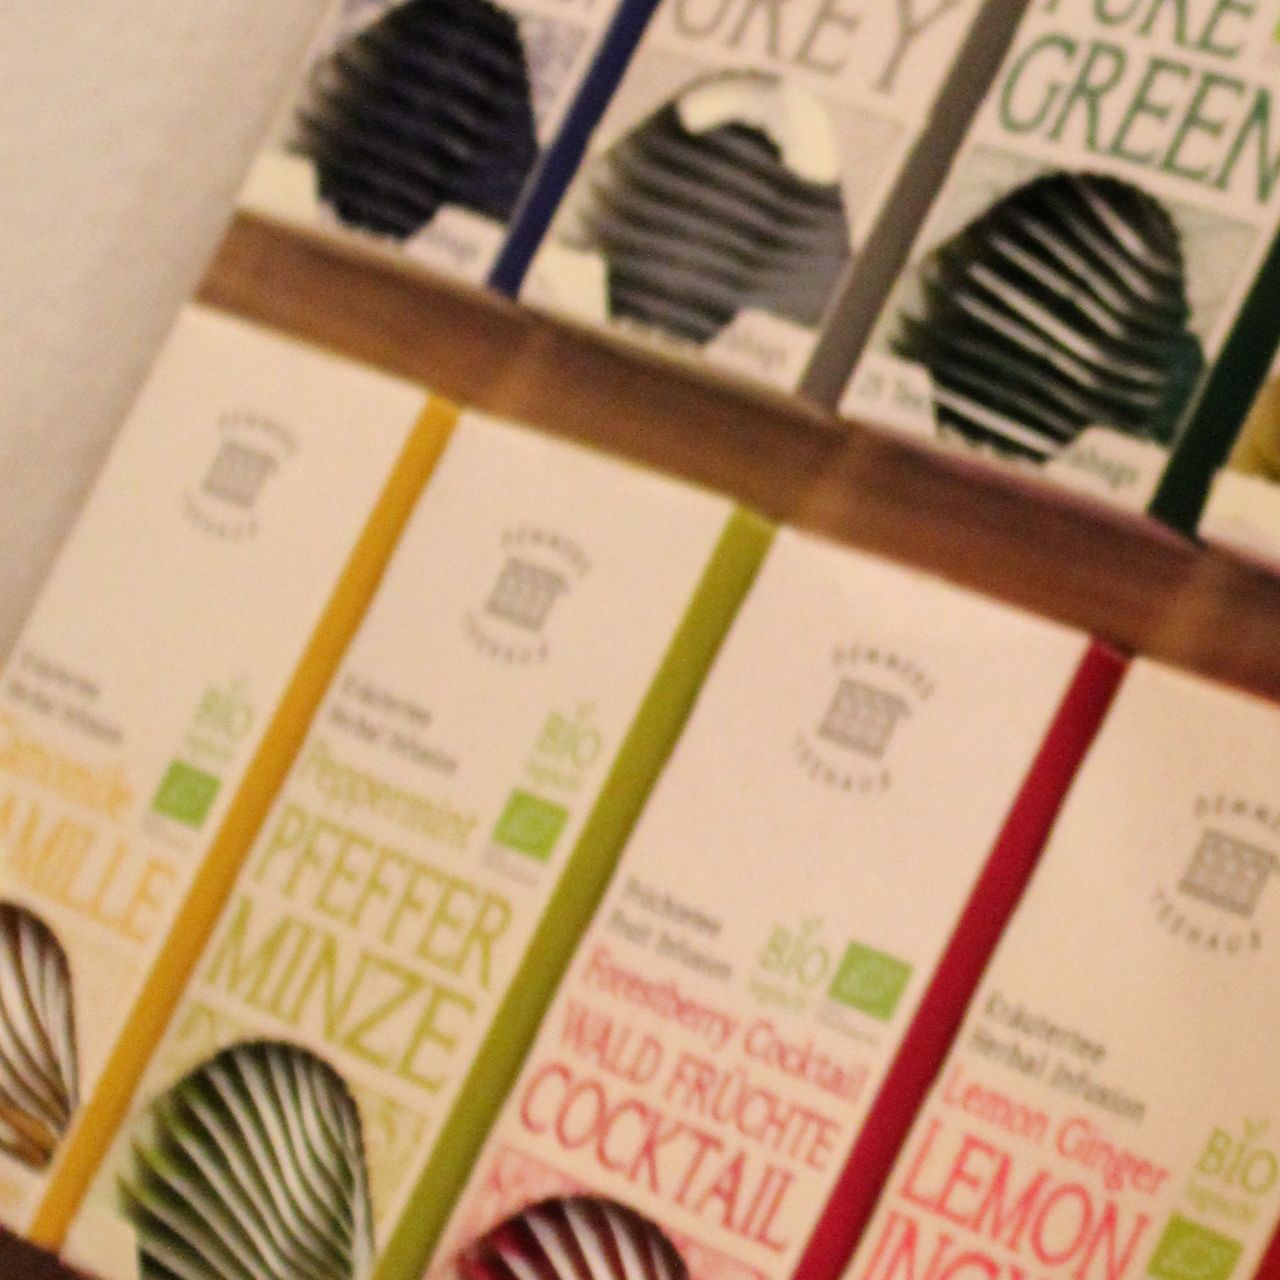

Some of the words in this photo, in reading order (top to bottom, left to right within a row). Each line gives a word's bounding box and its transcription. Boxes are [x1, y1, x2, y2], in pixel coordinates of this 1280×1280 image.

[304, 738, 480, 851] Peppermint
[252, 802, 515, 991] PFEFFER
[758, 923, 831, 986] BIO
[205, 893, 479, 1093] MINZE
[743, 1018, 873, 1104] Cocktail
[520, 1060, 798, 1253] COCKTAIL
[561, 996, 663, 1085] WALD
[663, 1050, 843, 1173] FRÜCHTE
[940, 1063, 1052, 1145] Lemon
[1056, 1117, 1173, 1198] Ginger
